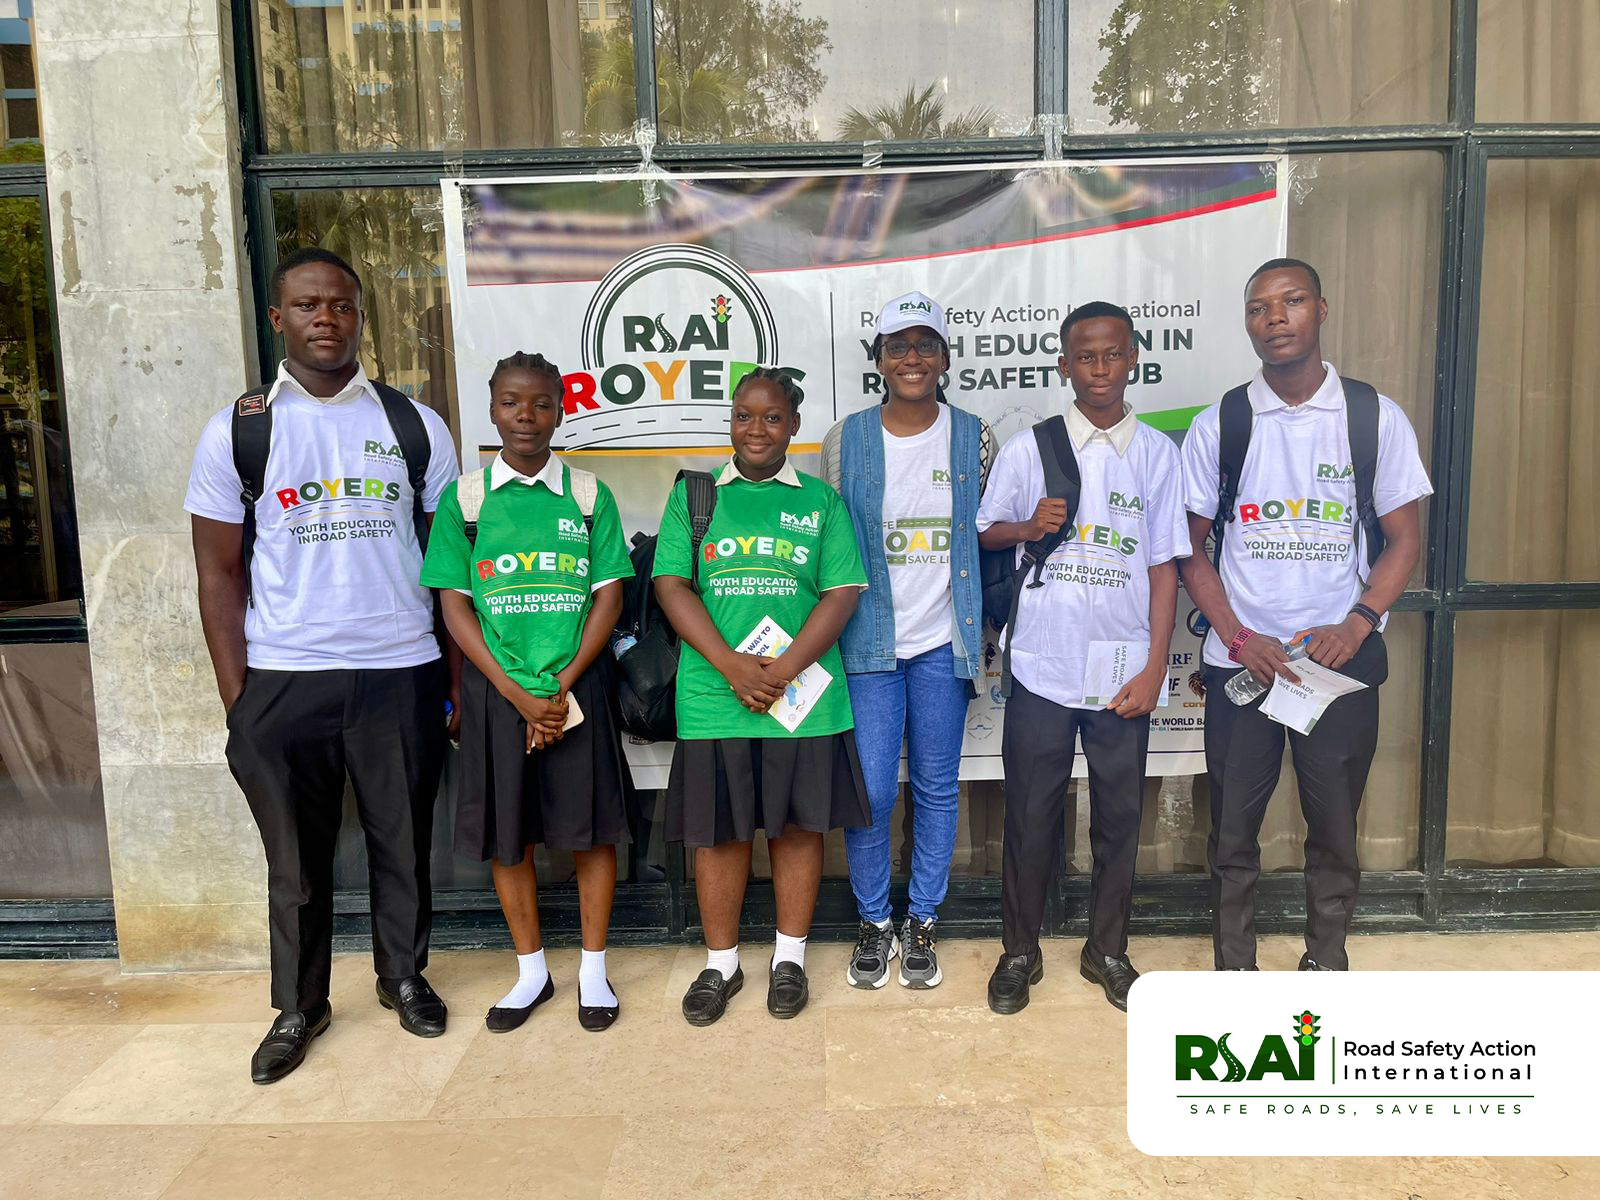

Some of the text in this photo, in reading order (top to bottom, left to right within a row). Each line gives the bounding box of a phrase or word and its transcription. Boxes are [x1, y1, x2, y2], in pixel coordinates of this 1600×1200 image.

[991, 304, 1059, 323] Action
[1163, 328, 1193, 351] IN
[276, 478, 400, 510] ROYERS
[288, 519, 396, 536] YOUTH EDUCATION
[298, 529, 394, 545] IN ROAD SAFETY
[704, 536, 810, 565] ROYERS
[1243, 540, 1286, 551] YOUTH
[908, 555, 936, 564] SAVE
[1251, 551, 1347, 562] IN ROAD SAFETY
[476, 552, 590, 580] ROYERS
[1045, 563, 1132, 580] YOUTH EDUCATION
[1046, 572, 1127, 589] IN ROAD SAFETY
[485, 593, 586, 606] YOUTH EDUCATION
[725, 587, 755, 596] ROAD
[757, 587, 798, 596] SAFETY
[491, 603, 582, 615] IN ROAD SAFETY
[747, 625, 771, 652] WAY TO
[1290, 685, 1308, 699] LIVES
[1162, 717, 1194, 726] WORLD
